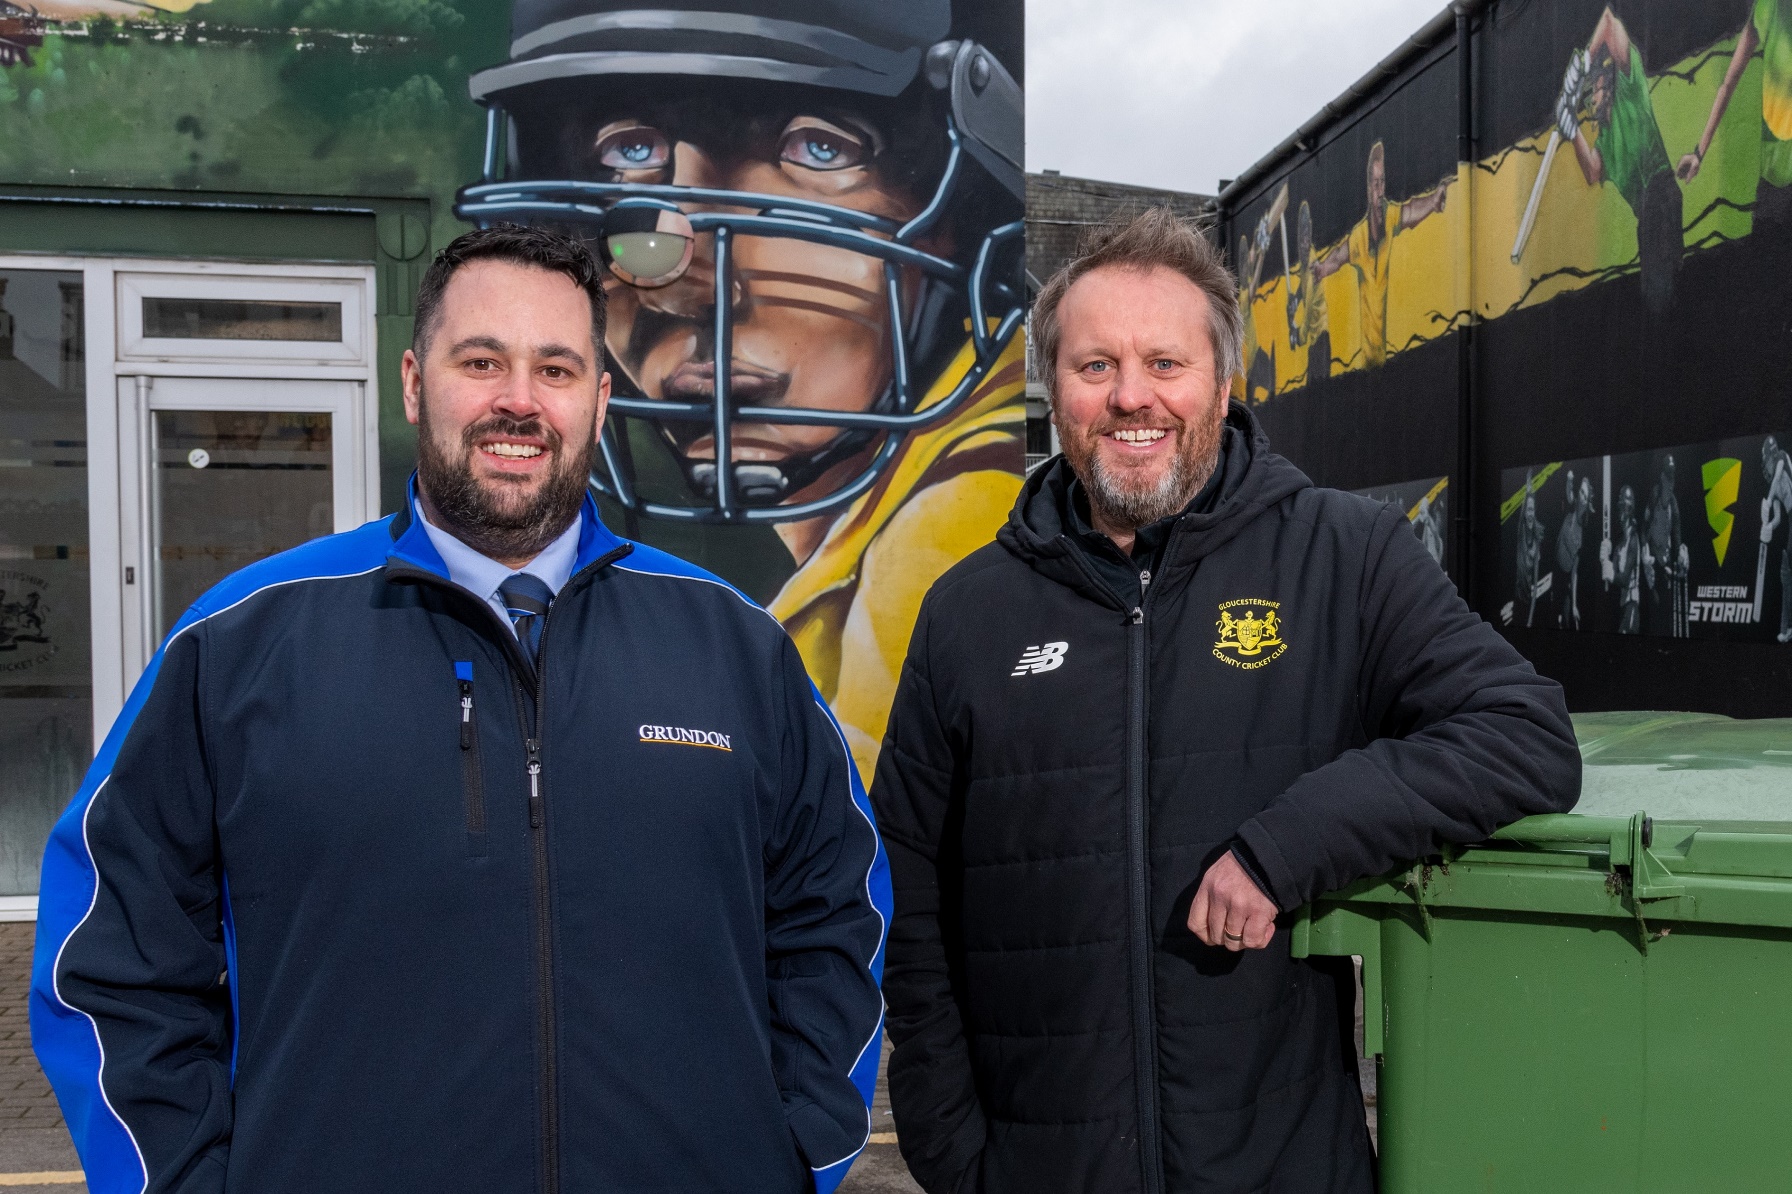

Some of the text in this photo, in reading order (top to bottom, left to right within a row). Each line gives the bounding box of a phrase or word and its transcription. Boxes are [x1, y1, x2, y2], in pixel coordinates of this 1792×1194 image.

[1696, 585, 1748, 599] WESTERN
[1218, 598, 1281, 611] GLOUCESTERSHIRE
[1688, 601, 1753, 624] STORM
[1212, 643, 1288, 670] COUNTY CRICKET CLUB
[639, 724, 731, 749] GRUNDON
